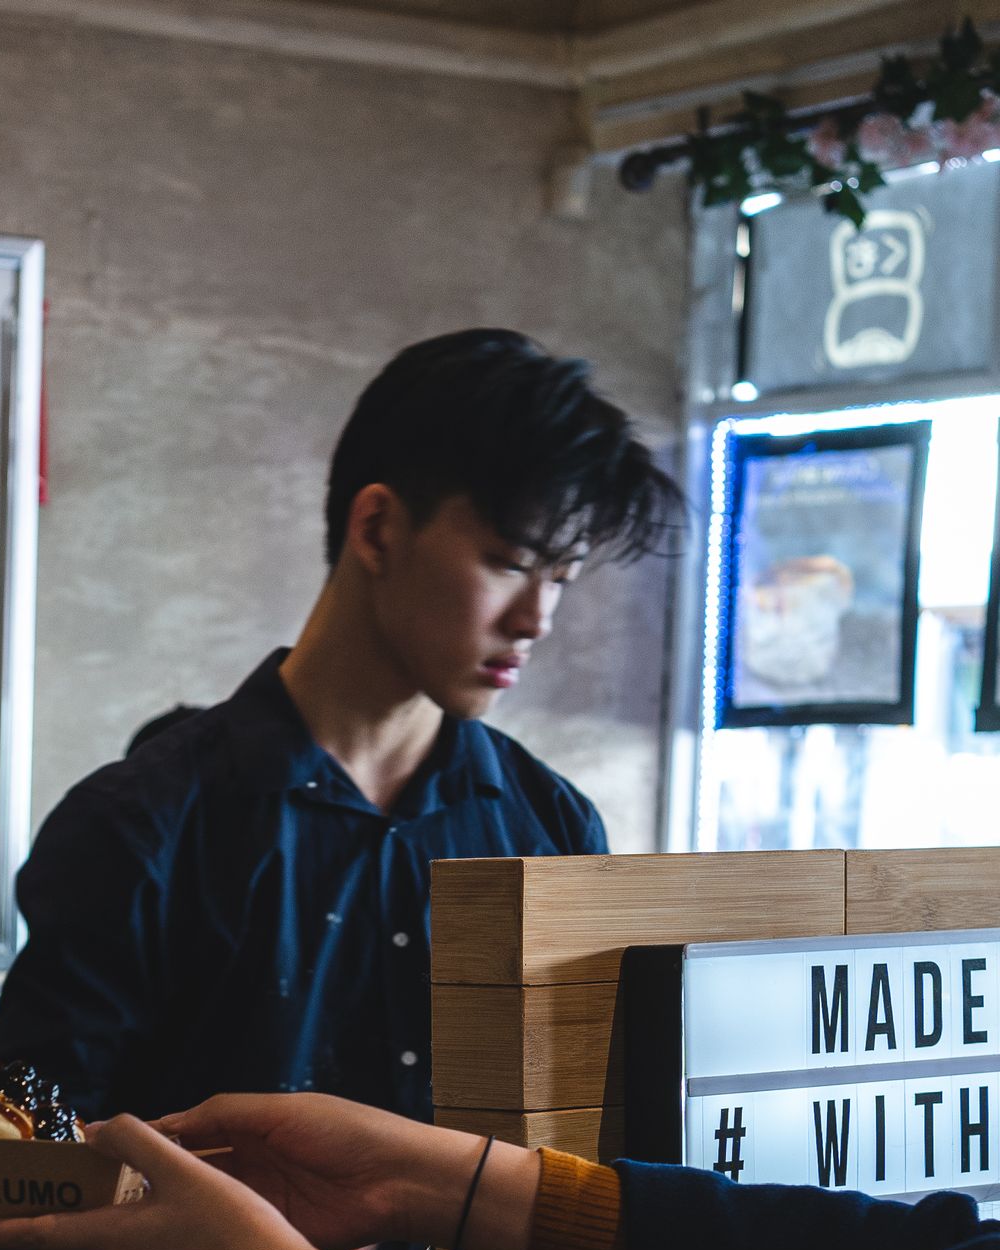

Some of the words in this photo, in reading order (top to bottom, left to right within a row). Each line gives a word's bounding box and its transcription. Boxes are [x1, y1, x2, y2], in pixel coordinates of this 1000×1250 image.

[811, 957, 989, 1055] MADE
[713, 1107, 747, 1183] #
[812, 1086, 990, 1188] WITH
